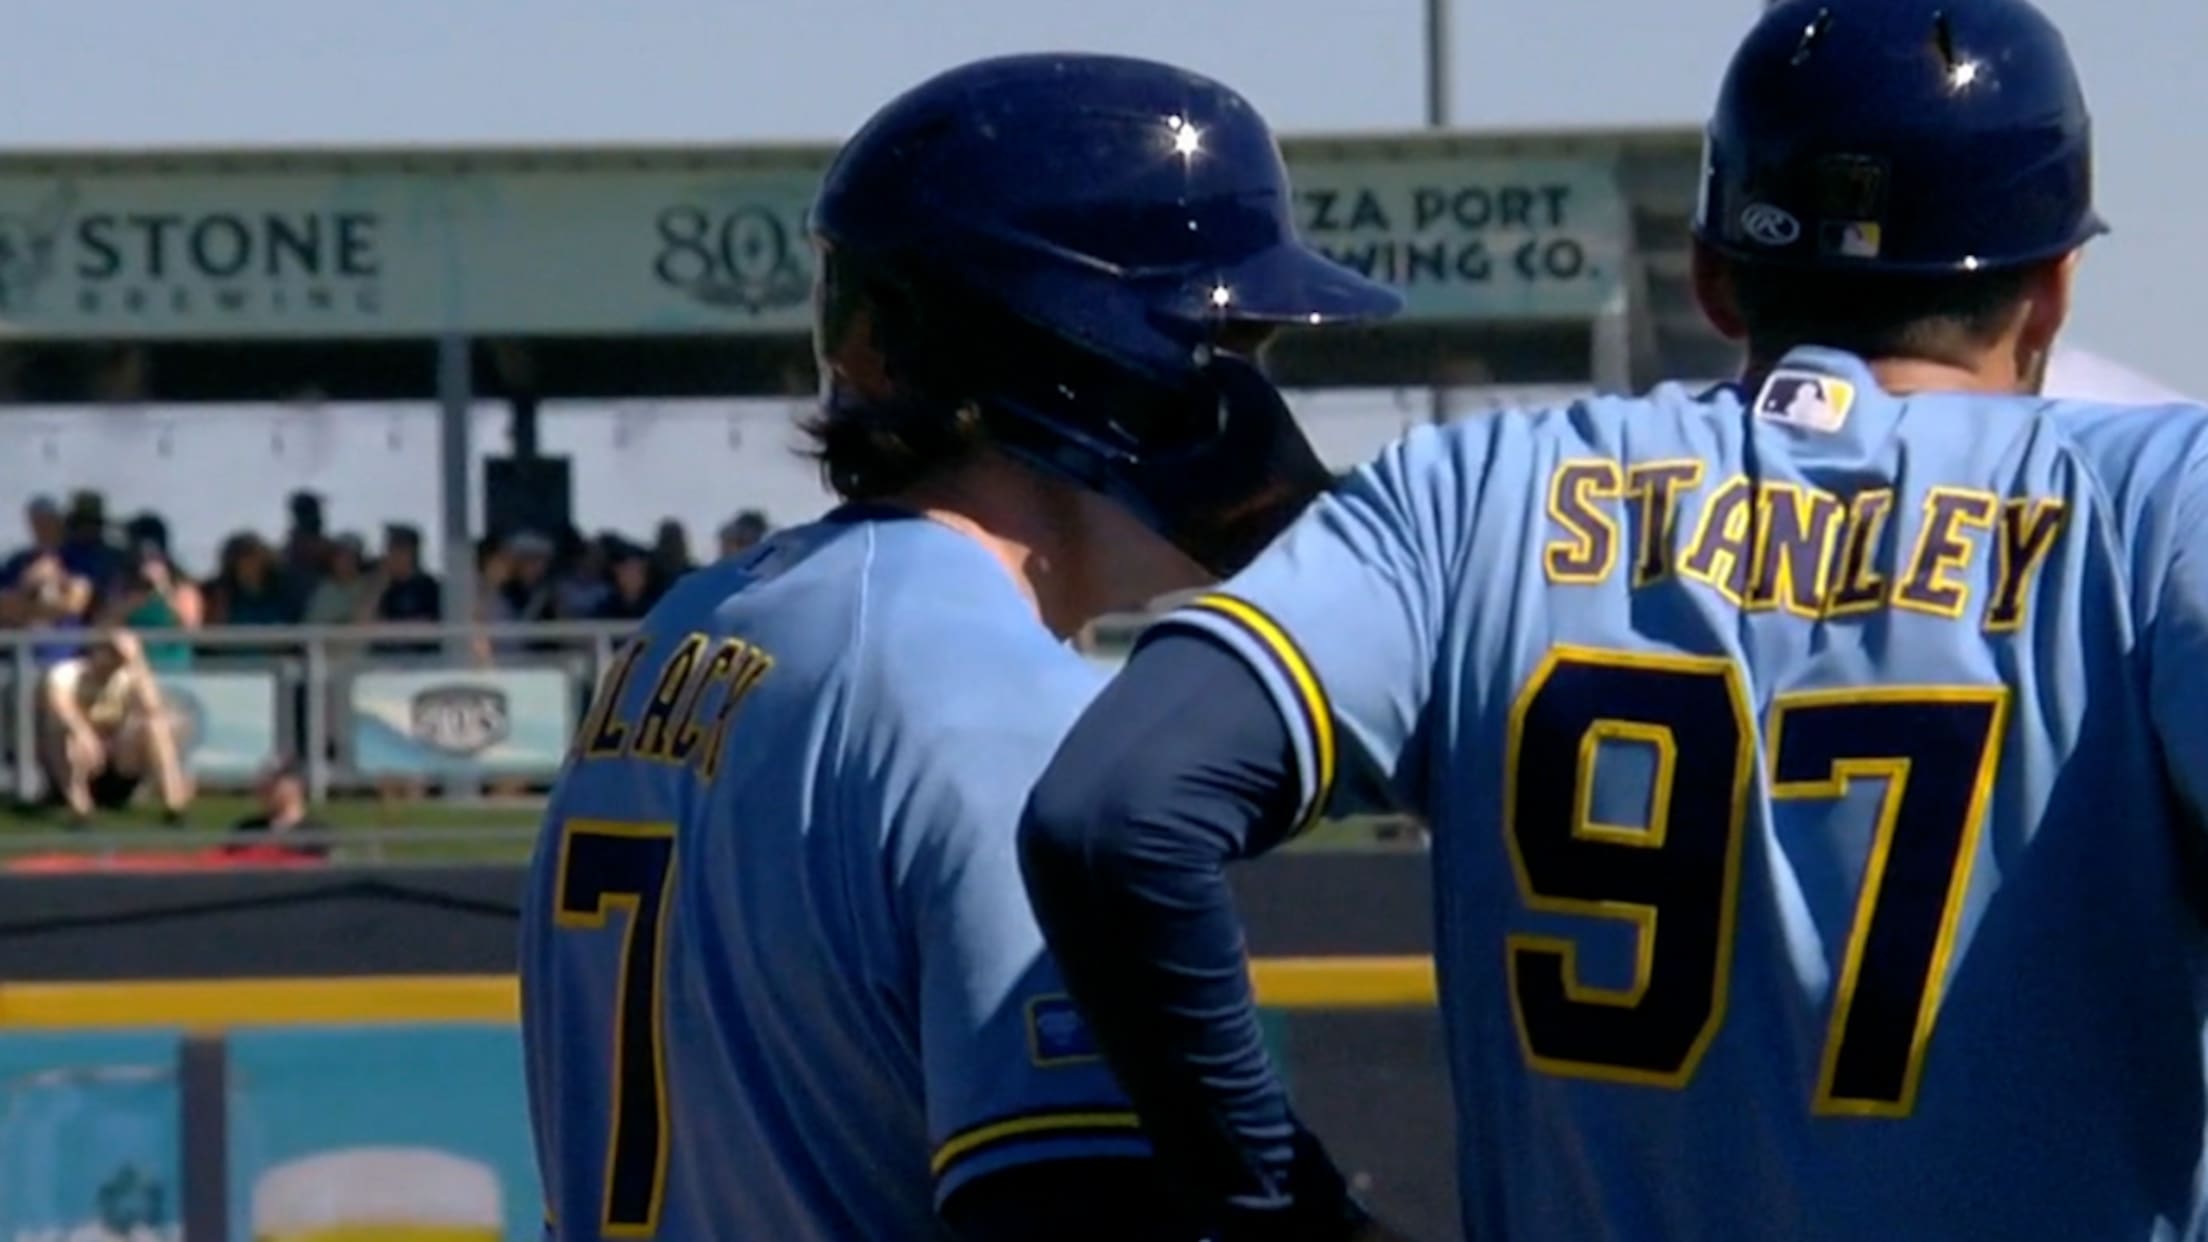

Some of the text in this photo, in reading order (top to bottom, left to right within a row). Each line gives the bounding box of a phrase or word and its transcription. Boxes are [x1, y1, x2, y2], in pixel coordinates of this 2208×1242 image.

[76, 212, 381, 279] STONE
[655, 204, 809, 290] 80
[1297, 184, 1573, 231] ZA PORT
[1515, 237, 1601, 280] CO.
[1544, 458, 2063, 634] STANLEY
[1505, 642, 2010, 1118] 97
[554, 819, 678, 1239] 7
